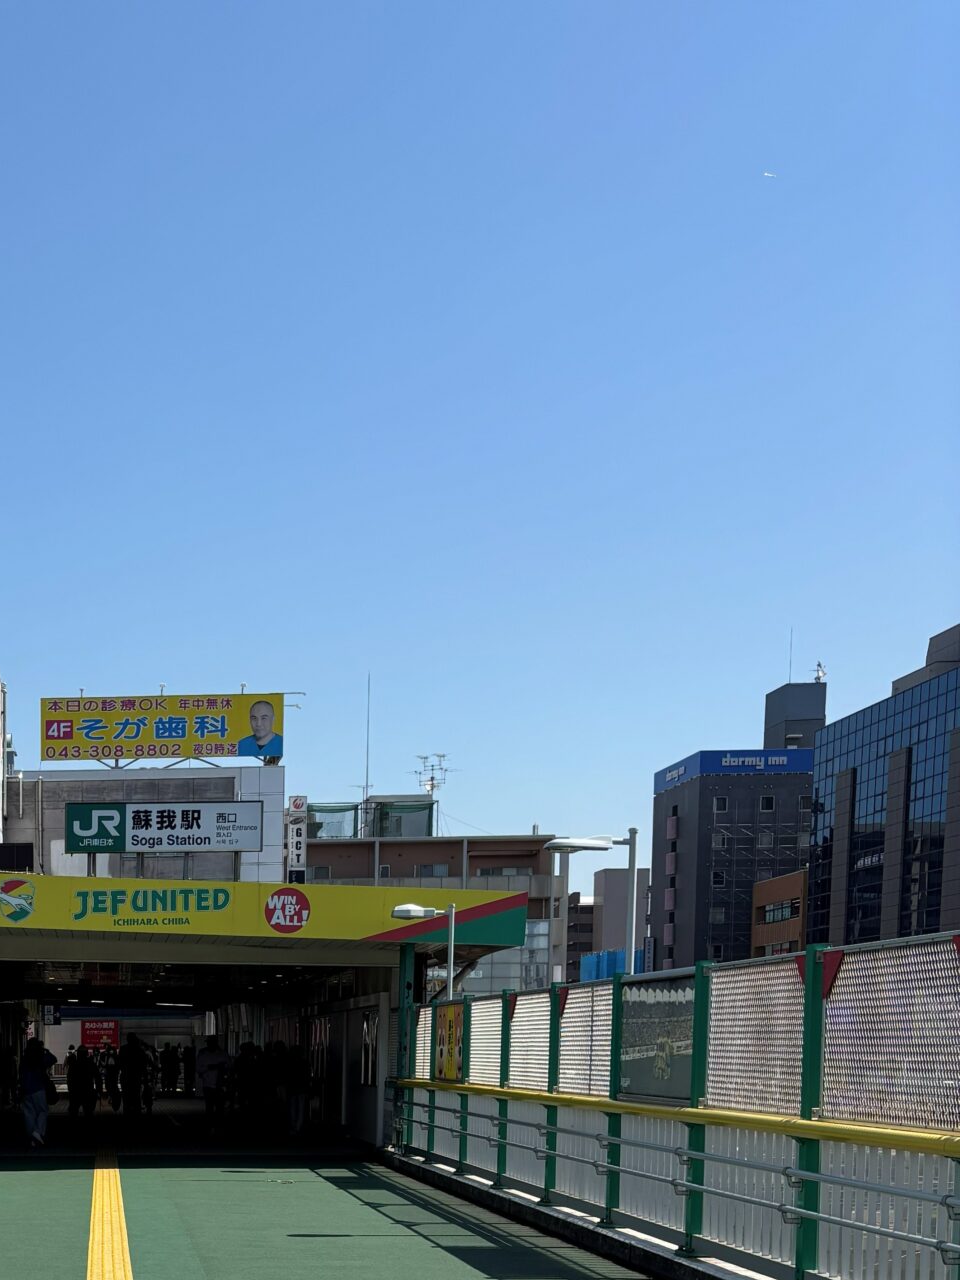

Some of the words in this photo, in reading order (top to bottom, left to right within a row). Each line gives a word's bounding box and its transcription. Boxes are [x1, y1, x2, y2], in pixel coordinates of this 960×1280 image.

[178, 698, 233, 711] 年中無休
[47, 722, 71, 738] 4F
[75, 714, 229, 741] そが歯科
[45, 743, 182, 759] 043-308-8802
[722, 753, 765, 769] dormy
[73, 809, 121, 837] JR
[131, 809, 202, 831] 蘇我駅
[216, 813, 237, 823] 西口
[131, 834, 163, 849] Soga
[166, 833, 211, 847] Station
[72, 890, 128, 920] JEF
[131, 888, 231, 913] UNITED
[267, 895, 296, 910] WIN
[285, 904, 301, 915] BY
[113, 917, 160, 927] ICHIHARA
[161, 917, 191, 926] CHIBA
[270, 910, 309, 927] ALL!
